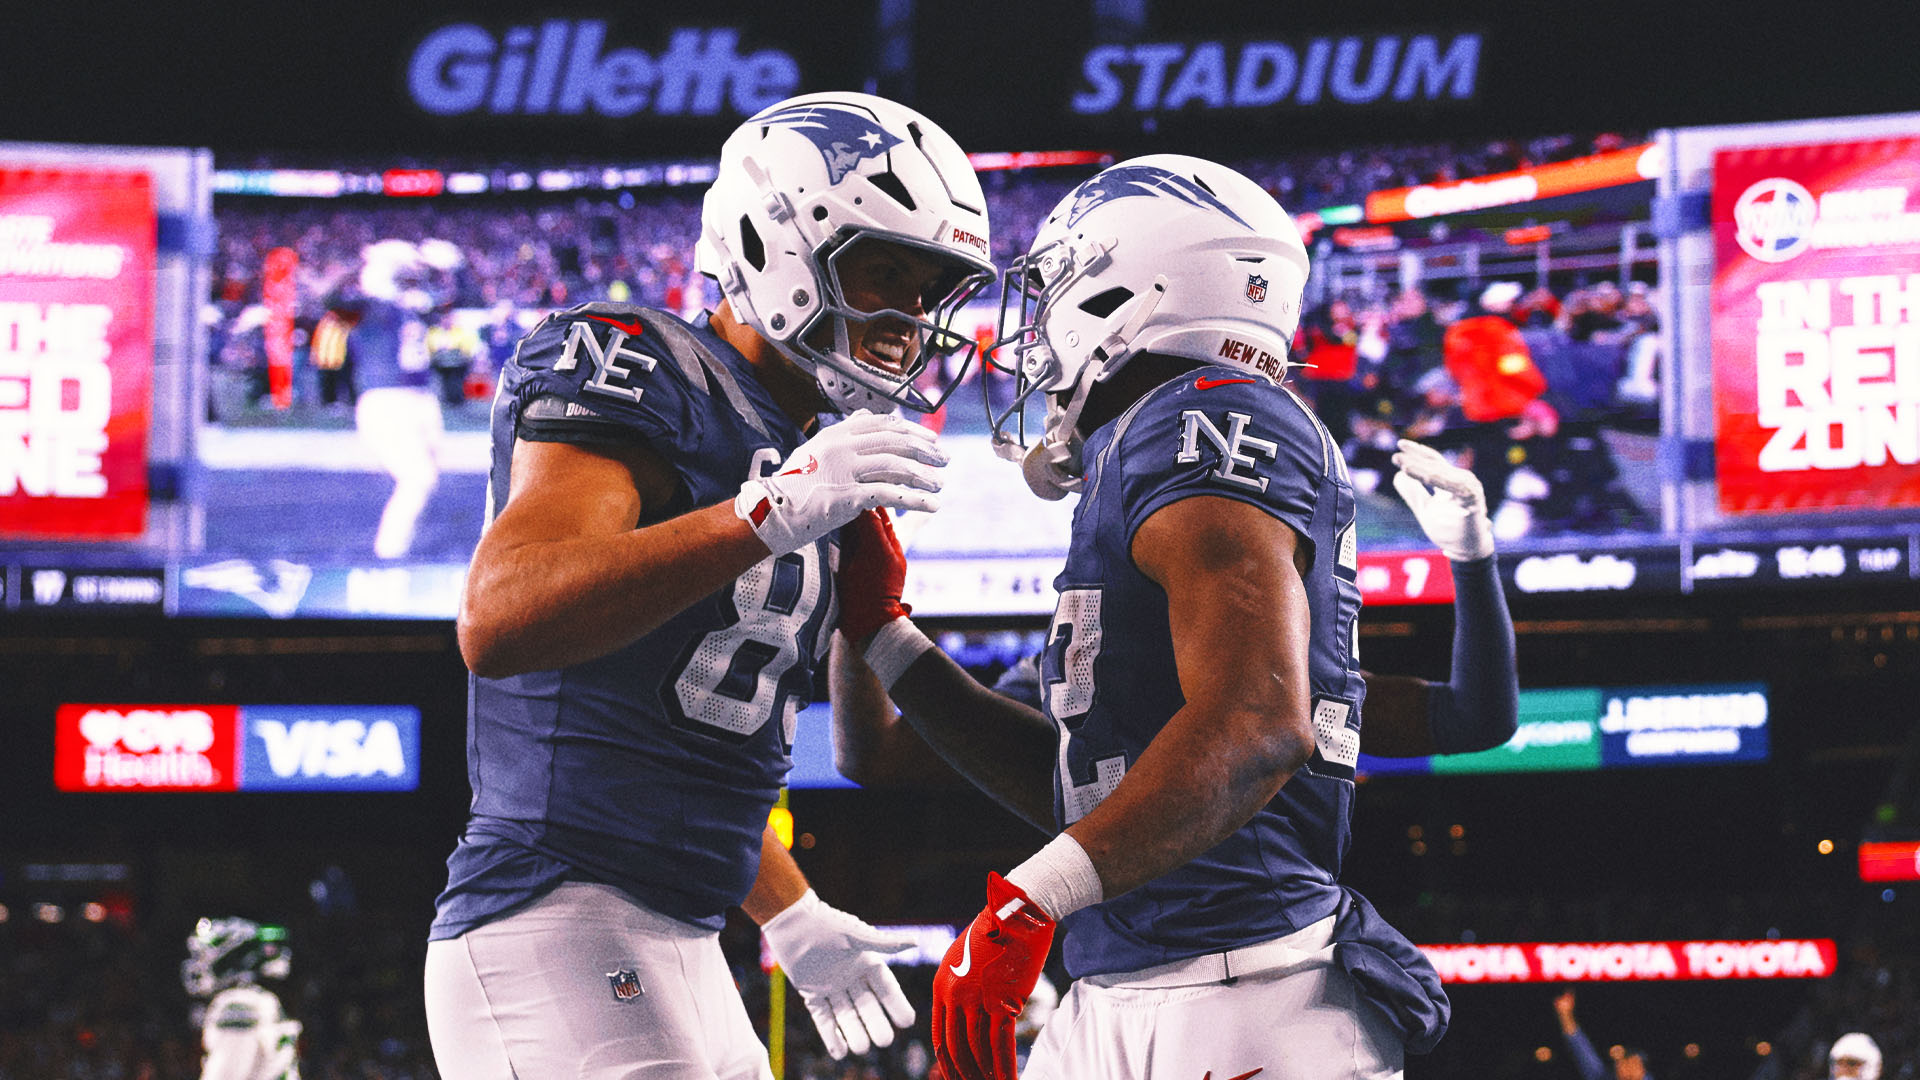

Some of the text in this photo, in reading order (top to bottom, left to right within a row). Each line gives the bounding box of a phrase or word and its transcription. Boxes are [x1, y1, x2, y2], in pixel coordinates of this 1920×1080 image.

[408, 19, 1481, 117] Gillette STADIUM
[953, 228, 987, 255] PATRIOTS
[1248, 284, 1265, 300] NFL
[1757, 278, 1831, 329] IN
[553, 321, 657, 403] NE
[1218, 338, 1257, 364] NEW
[1177, 410, 1278, 493] NE
[1402, 557, 1430, 598] 7
[253, 719, 405, 777] VISA
[1420, 941, 1826, 980] YOTA TOYOTA TOYOTA
